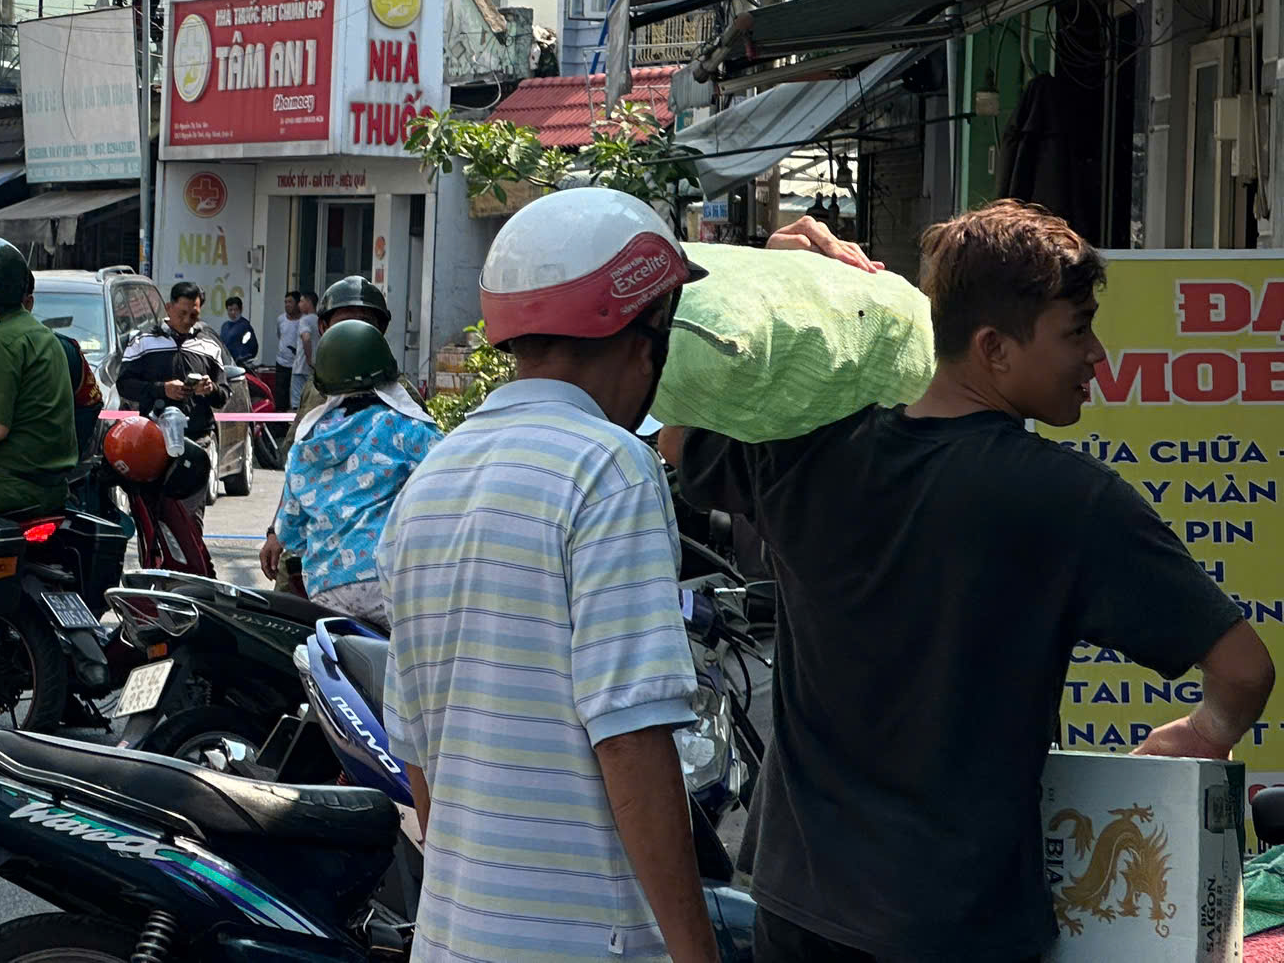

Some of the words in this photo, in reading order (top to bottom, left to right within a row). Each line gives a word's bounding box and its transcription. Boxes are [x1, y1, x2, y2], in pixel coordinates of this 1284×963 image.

[307, 0, 325, 19] GPP
[216, 30, 265, 91] TÂM
[368, 31, 420, 85] NHÀ
[273, 94, 315, 113] Pharmacy
[179, 225, 229, 266] NHÀ
[613, 252, 668, 294] Excelite
[1149, 434, 1268, 464] CHỮA
[1184, 474, 1277, 503] MÀN
[1186, 521, 1254, 543] PIN
[1065, 681, 1130, 704] TAI
[1046, 837, 1065, 885] BIA
[1206, 878, 1216, 953] SAIGON
